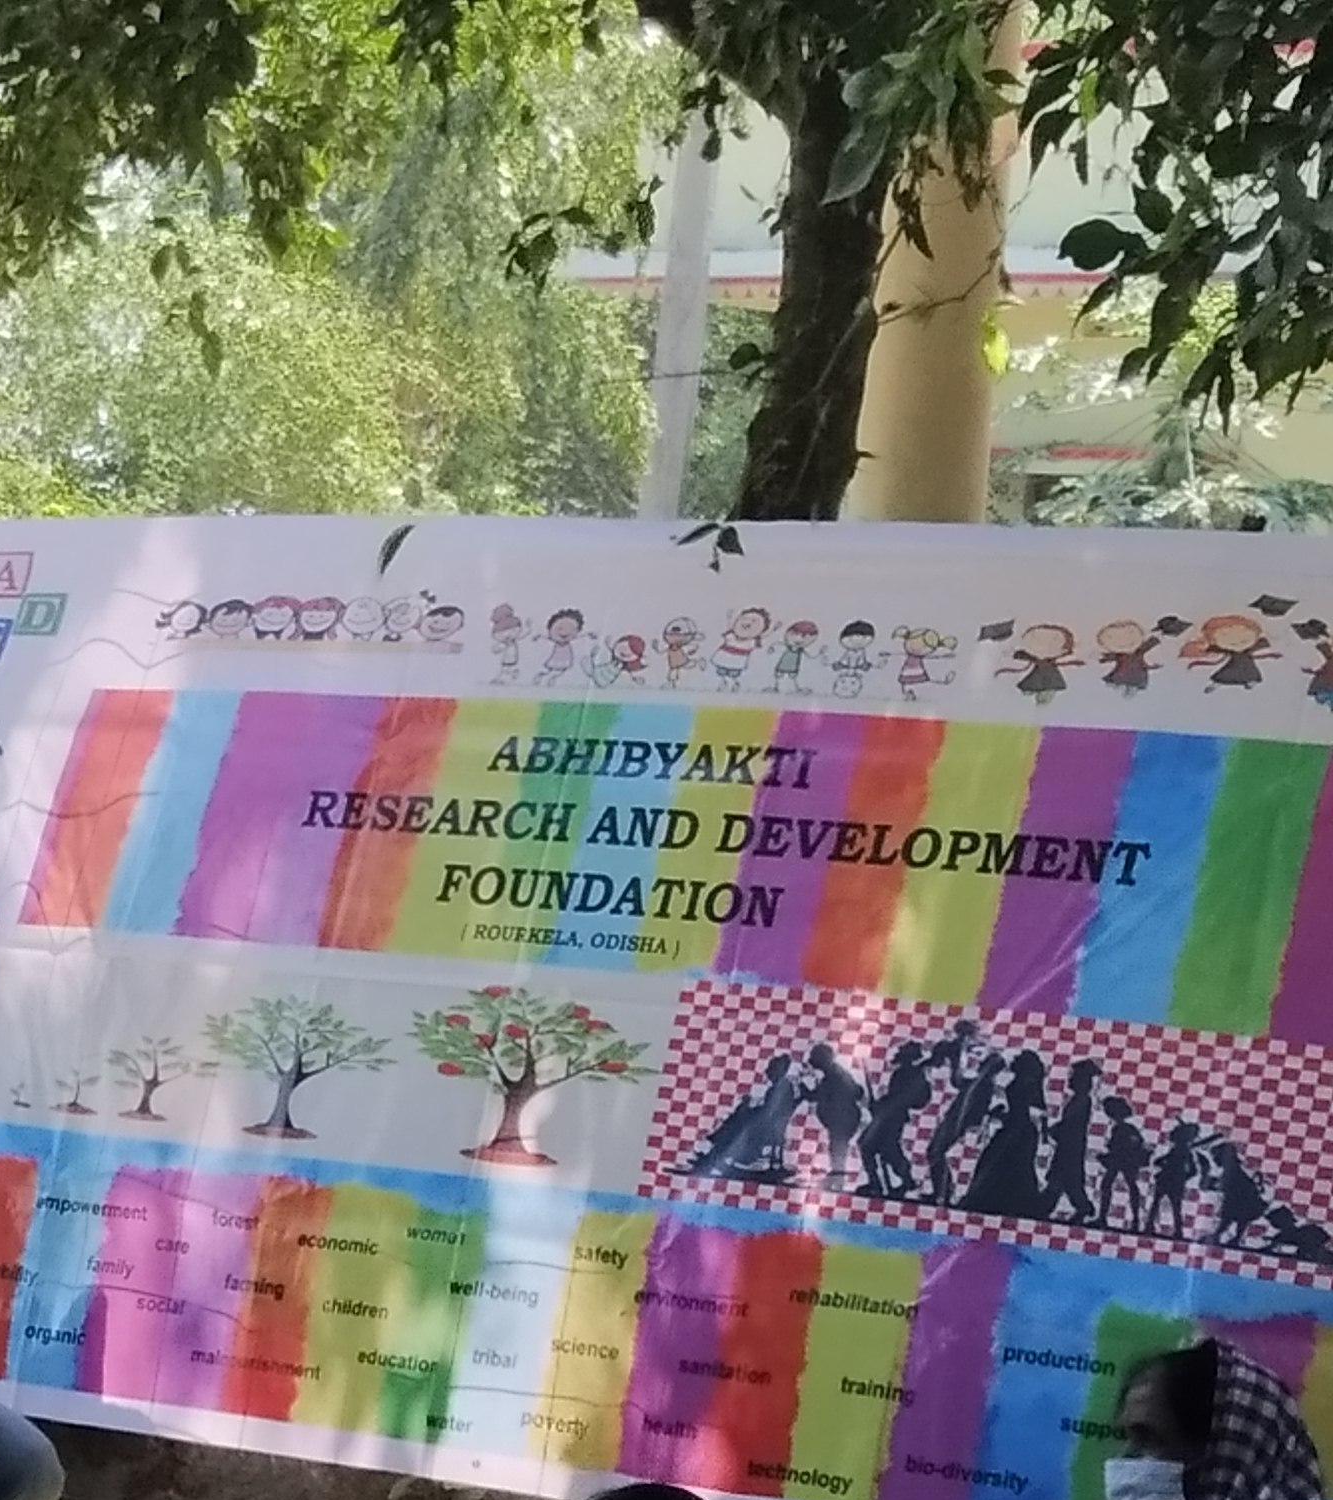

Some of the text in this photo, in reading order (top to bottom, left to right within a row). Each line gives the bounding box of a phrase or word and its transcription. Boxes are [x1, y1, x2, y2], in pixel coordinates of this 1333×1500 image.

[20, 600, 57, 630] D
[486, 735, 818, 790] ABHIBYAKTI
[301, 790, 1152, 887] RESEARCH AND DEVELOPMENT
[436, 864, 785, 928] FOUNDATION
[590, 932, 668, 955] ODISHA
[35, 1196, 148, 1223] empowerment
[211, 1210, 260, 1230] forest
[154, 1237, 190, 1255] care
[297, 1233, 380, 1257] economic
[573, 1244, 629, 1271] safety
[85, 1255, 135, 1281] family
[135, 1297, 186, 1316] social
[449, 1280, 540, 1310] well-being
[634, 1288, 750, 1319] environment
[788, 1287, 920, 1320] rehabilitation
[321, 1298, 389, 1320] children
[24, 1324, 87, 1346] organic
[356, 1348, 441, 1374] education
[471, 1348, 518, 1370] tribal
[551, 1337, 620, 1361] science
[1001, 1345, 1117, 1378] production
[189, 1349, 322, 1381] malurishment
[678, 1358, 772, 1386] sanitation
[840, 1375, 916, 1408] training
[425, 1413, 474, 1435] water
[519, 1411, 589, 1441] poverty
[641, 1414, 700, 1441] health
[746, 1460, 853, 1497] technology
[904, 1454, 1029, 1495] bio-diversity
